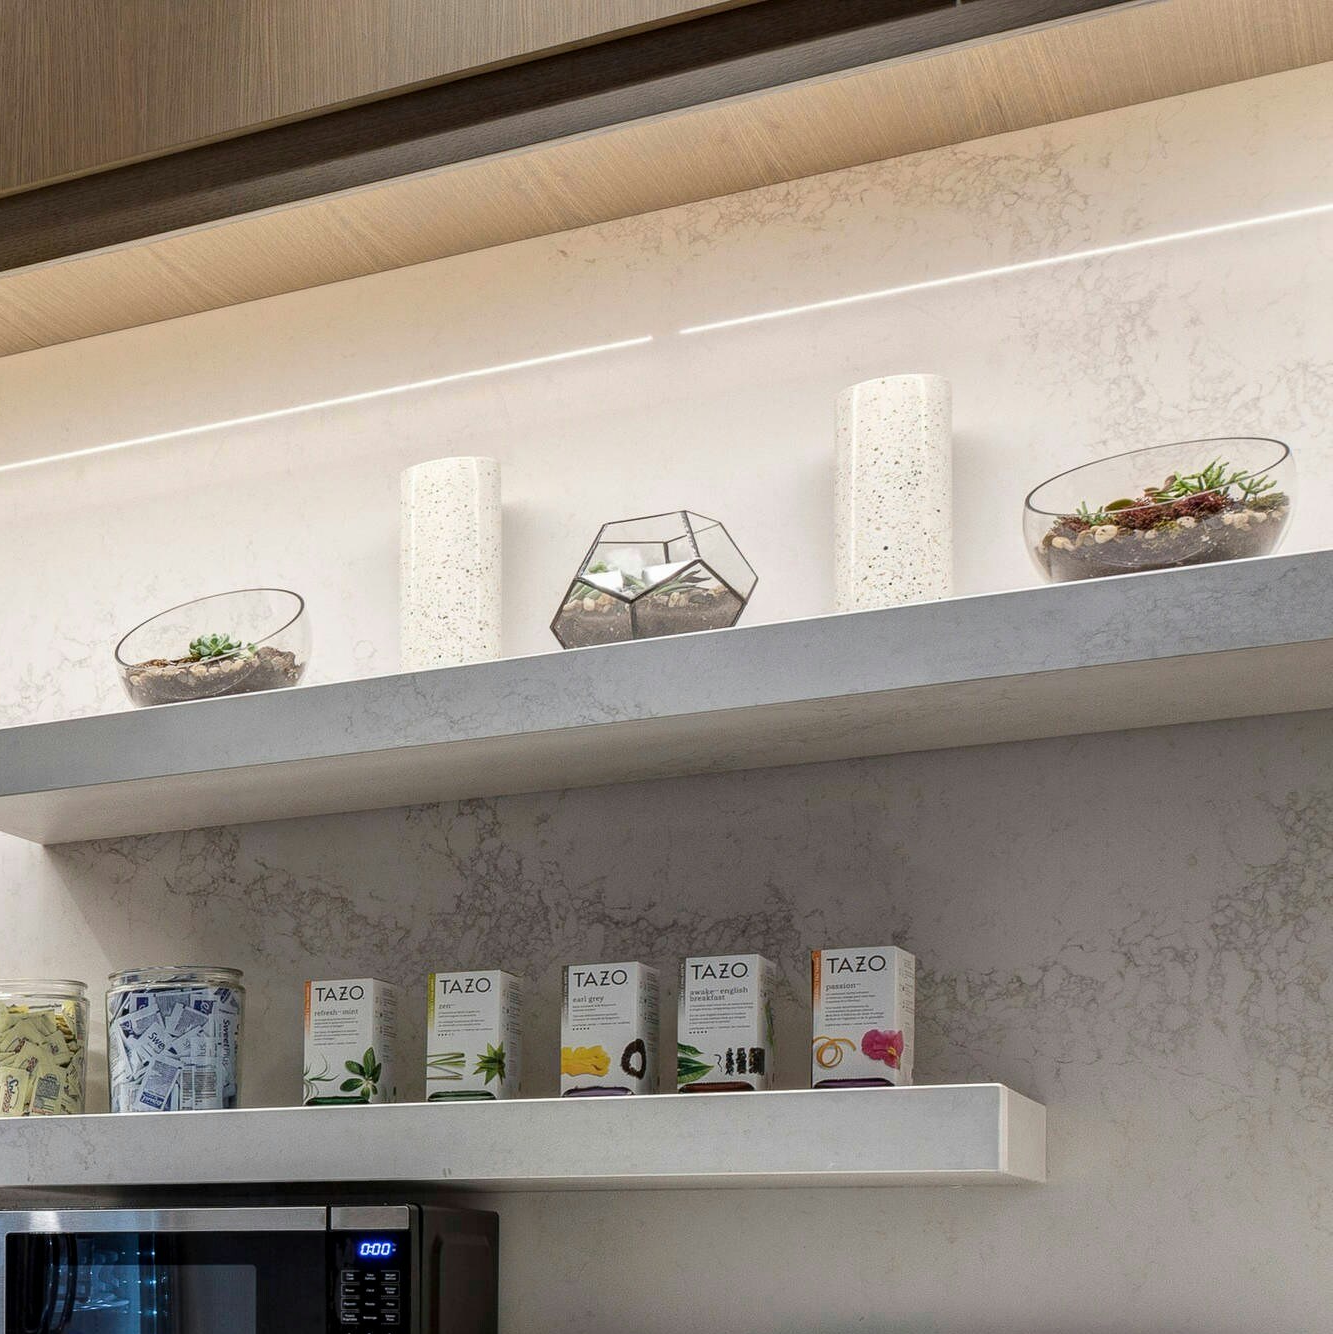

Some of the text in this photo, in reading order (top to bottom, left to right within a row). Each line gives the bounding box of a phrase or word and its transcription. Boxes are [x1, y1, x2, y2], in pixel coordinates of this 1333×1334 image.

[690, 962, 750, 980] TAZO
[826, 955, 887, 975] TAZO
[572, 968, 629, 989] TAZO
[315, 984, 366, 1003] TAZO
[439, 977, 492, 996] TAZO
[689, 985, 749, 998] awake english
[825, 982, 857, 992] passion
[572, 995, 605, 1006] earl grey
[688, 992, 726, 1002] breakfast
[313, 1007, 360, 1018] refresh mint
[359, 1242, 392, 1256] 0:00
